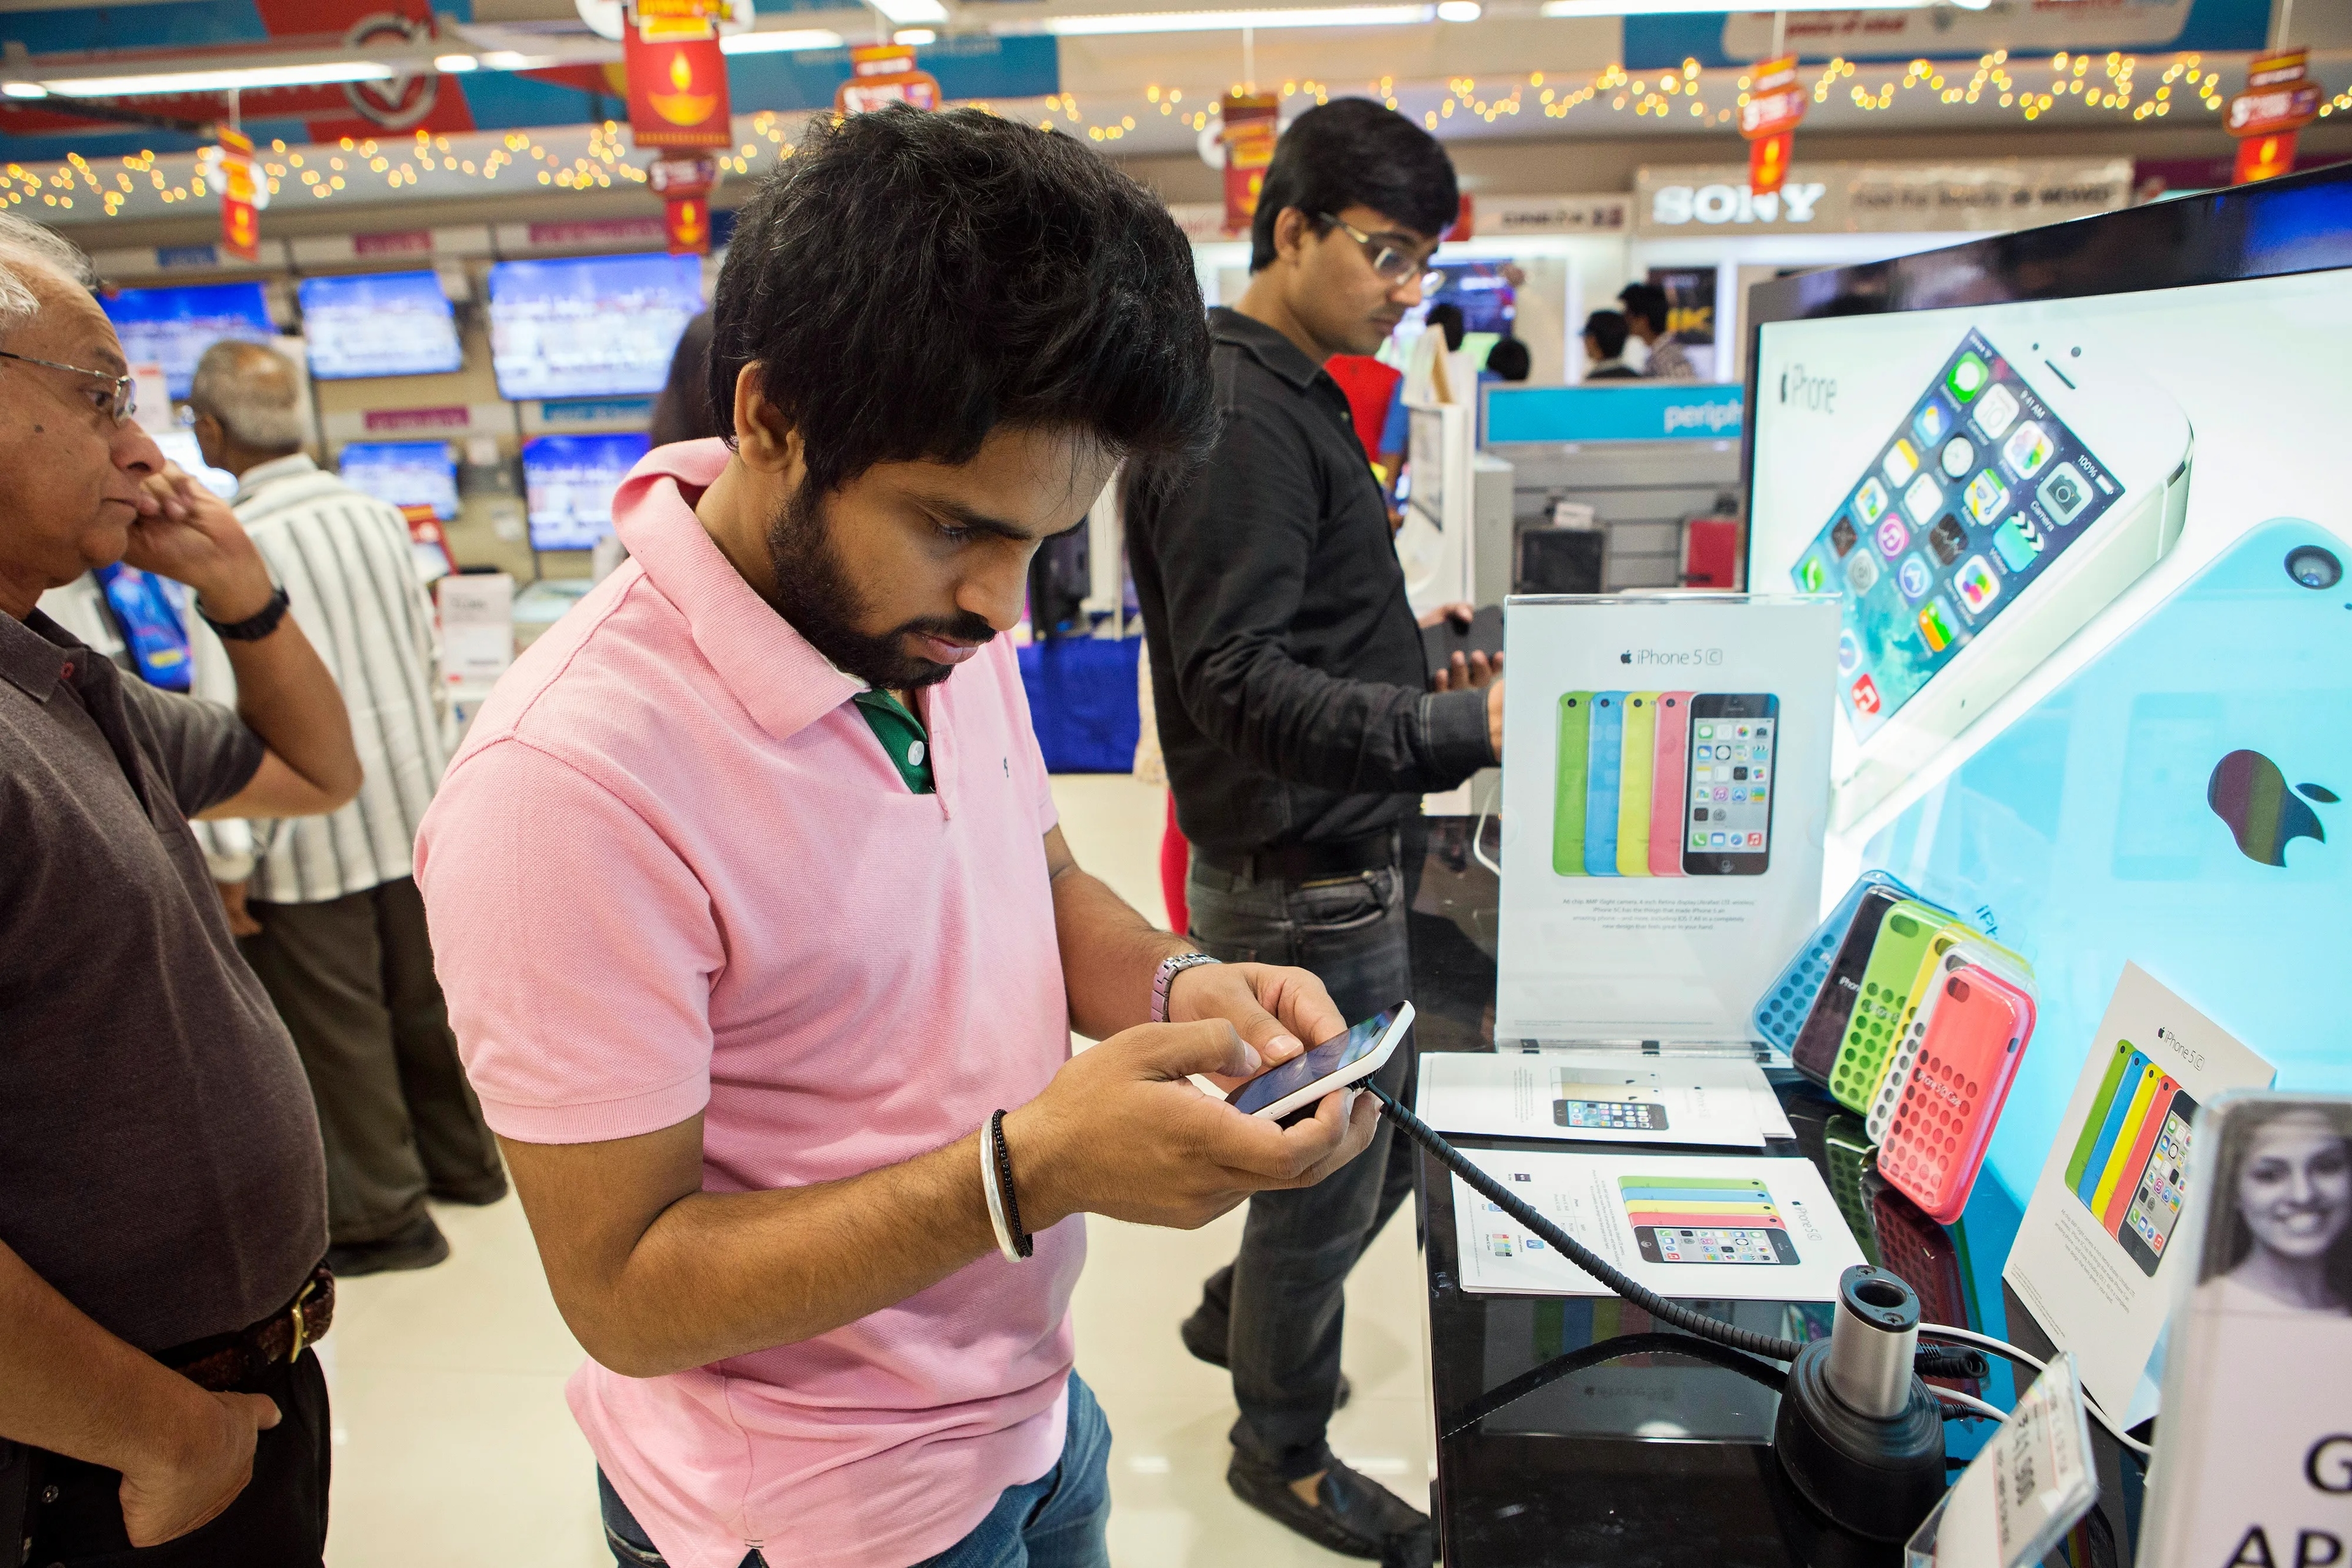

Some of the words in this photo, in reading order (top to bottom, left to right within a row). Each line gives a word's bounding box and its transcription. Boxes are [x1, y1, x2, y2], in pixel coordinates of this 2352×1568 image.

[1653, 183, 1826, 225] SONY
[2031, 404, 2046, 420] AM
[2078, 454, 2098, 478] 100%
[2030, 500, 2055, 533] Camera
[1637, 649, 1689, 665] iPhone
[2164, 1030, 2189, 1059] iPhone
[1794, 1207, 1812, 1227] iPhone
[2304, 1433, 2352, 1493] G
